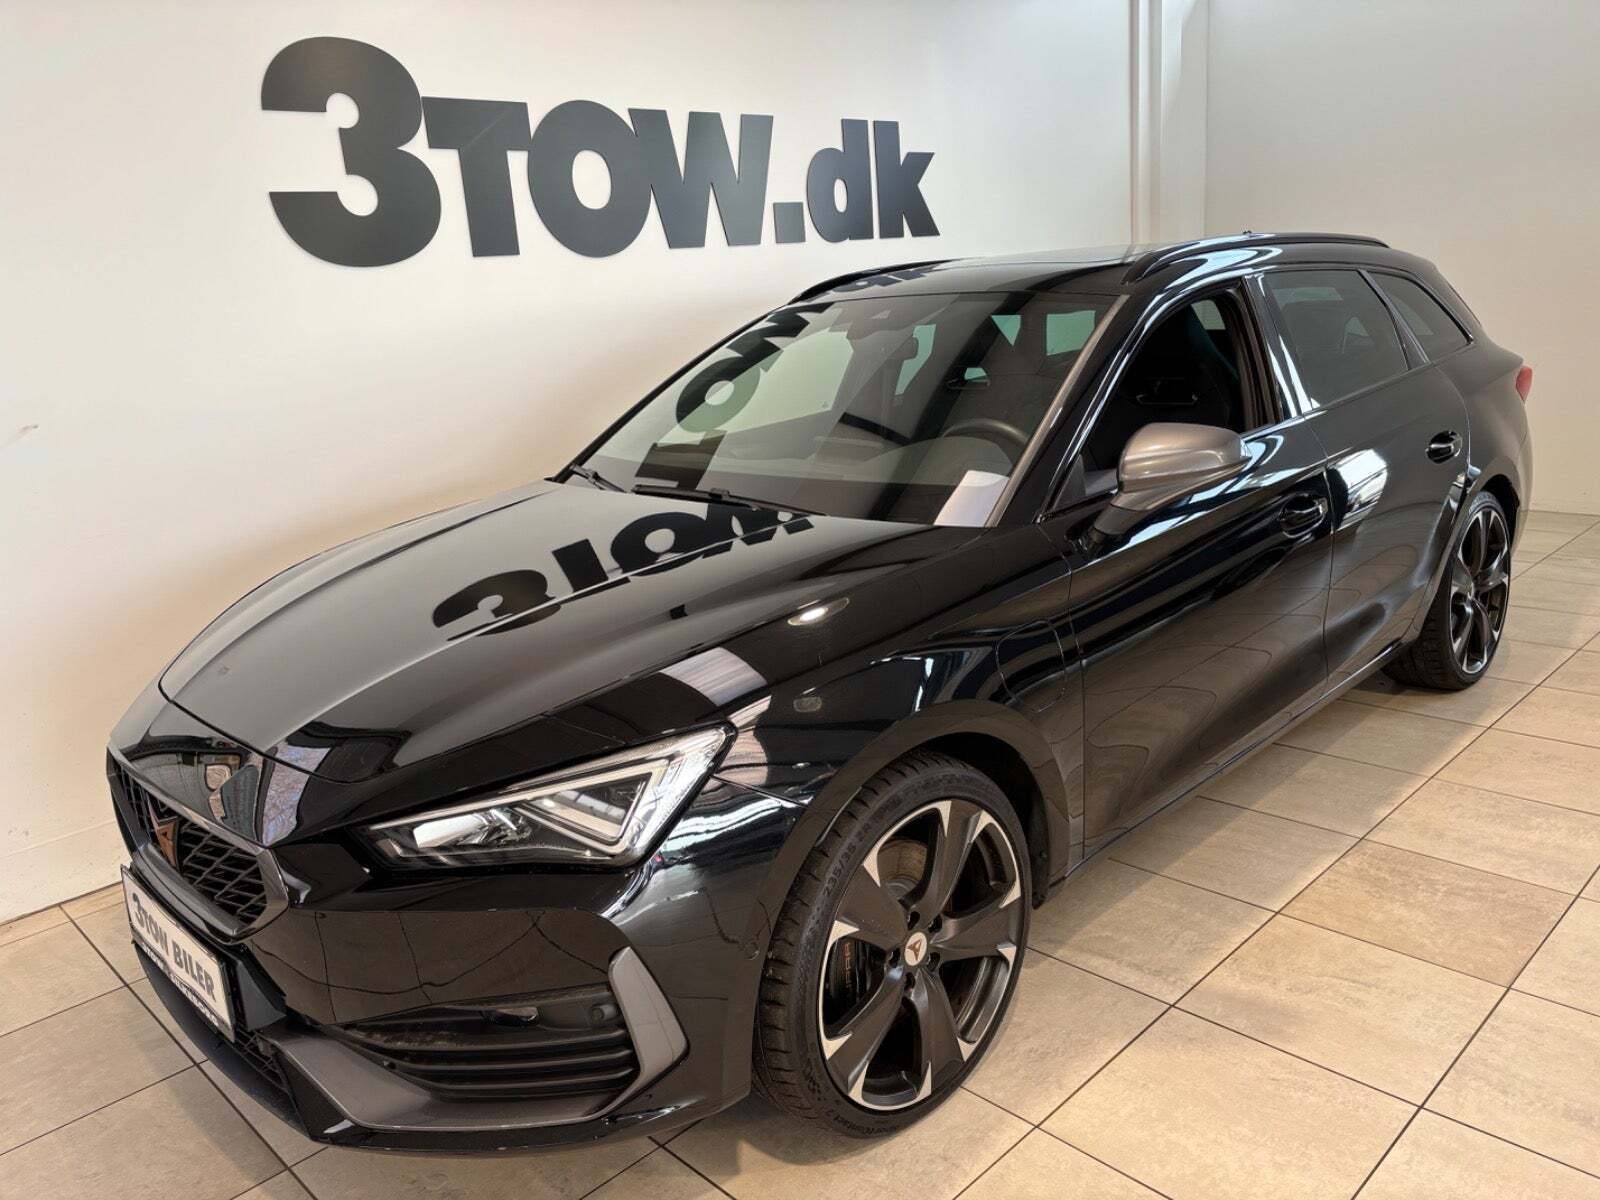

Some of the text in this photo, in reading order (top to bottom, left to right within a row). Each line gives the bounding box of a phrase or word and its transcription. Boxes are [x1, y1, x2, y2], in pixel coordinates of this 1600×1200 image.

[261, 36, 940, 267] 3TOW.dk
[132, 893, 170, 956] 3TOW
[171, 940, 217, 1003] BILER
